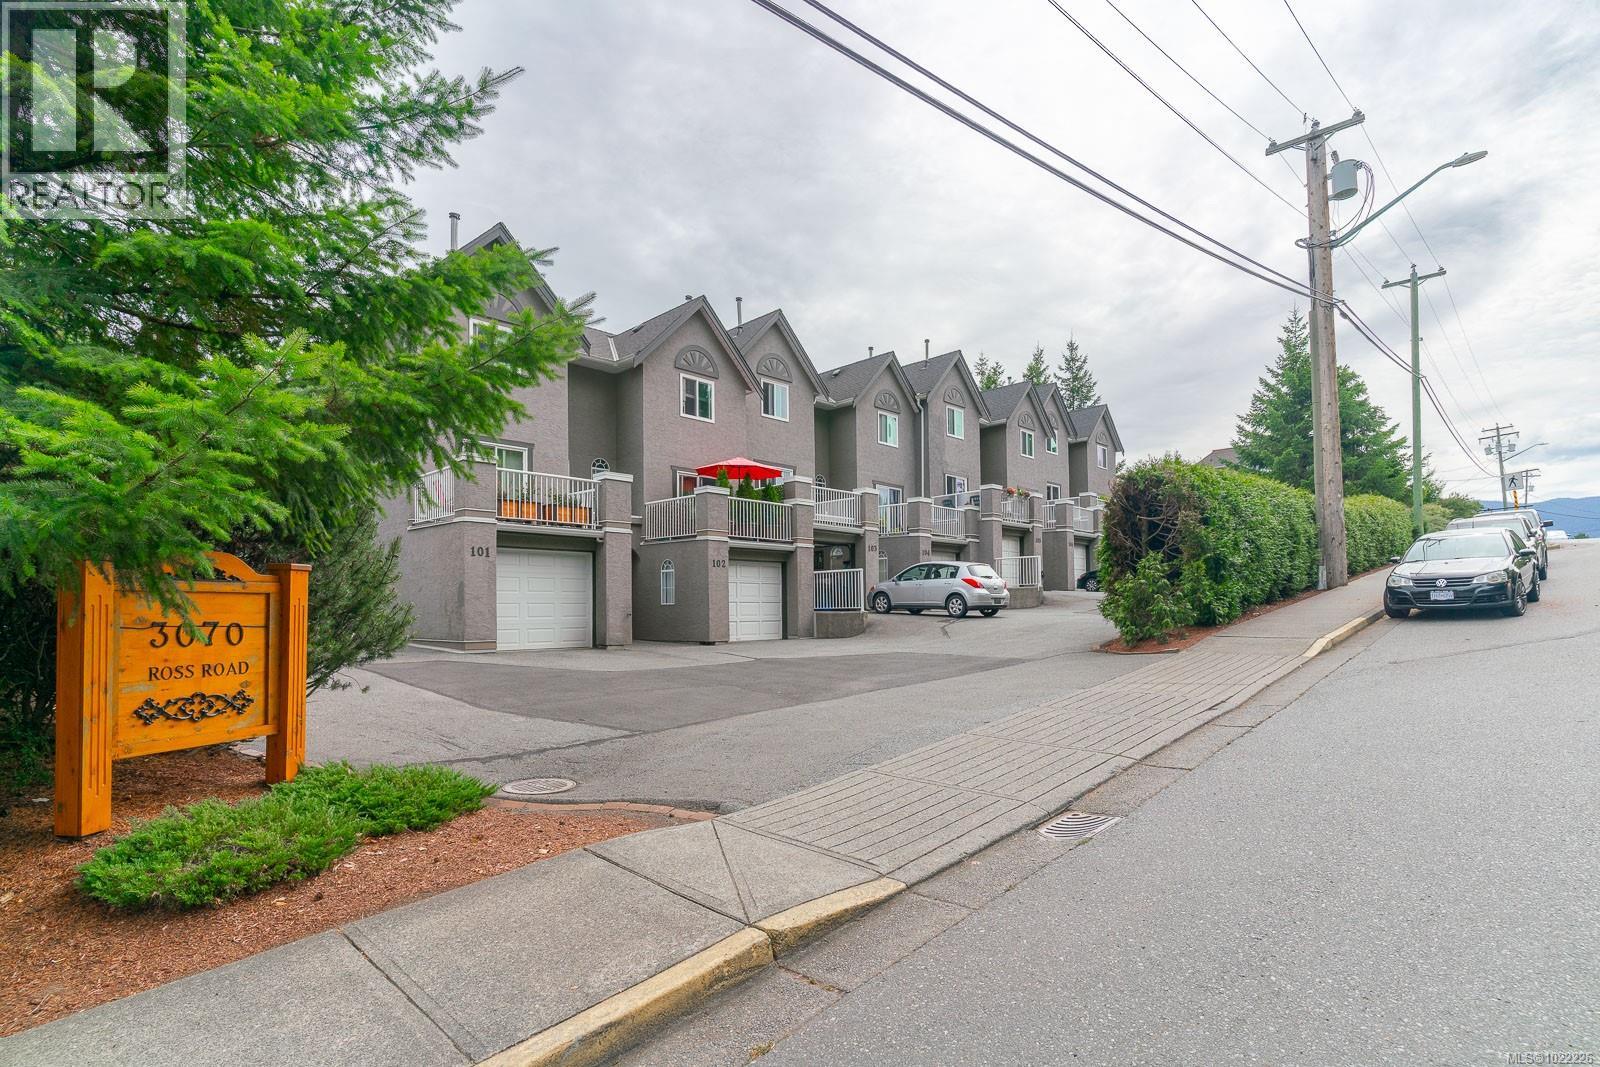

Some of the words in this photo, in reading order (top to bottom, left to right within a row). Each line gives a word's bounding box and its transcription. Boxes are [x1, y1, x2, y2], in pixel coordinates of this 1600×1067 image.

[470, 546, 490, 558] 101
[712, 559, 727, 569] 102
[150, 622, 244, 648] 3070
[148, 664, 195, 681] ROSS
[202, 661, 249, 678] ROAD
